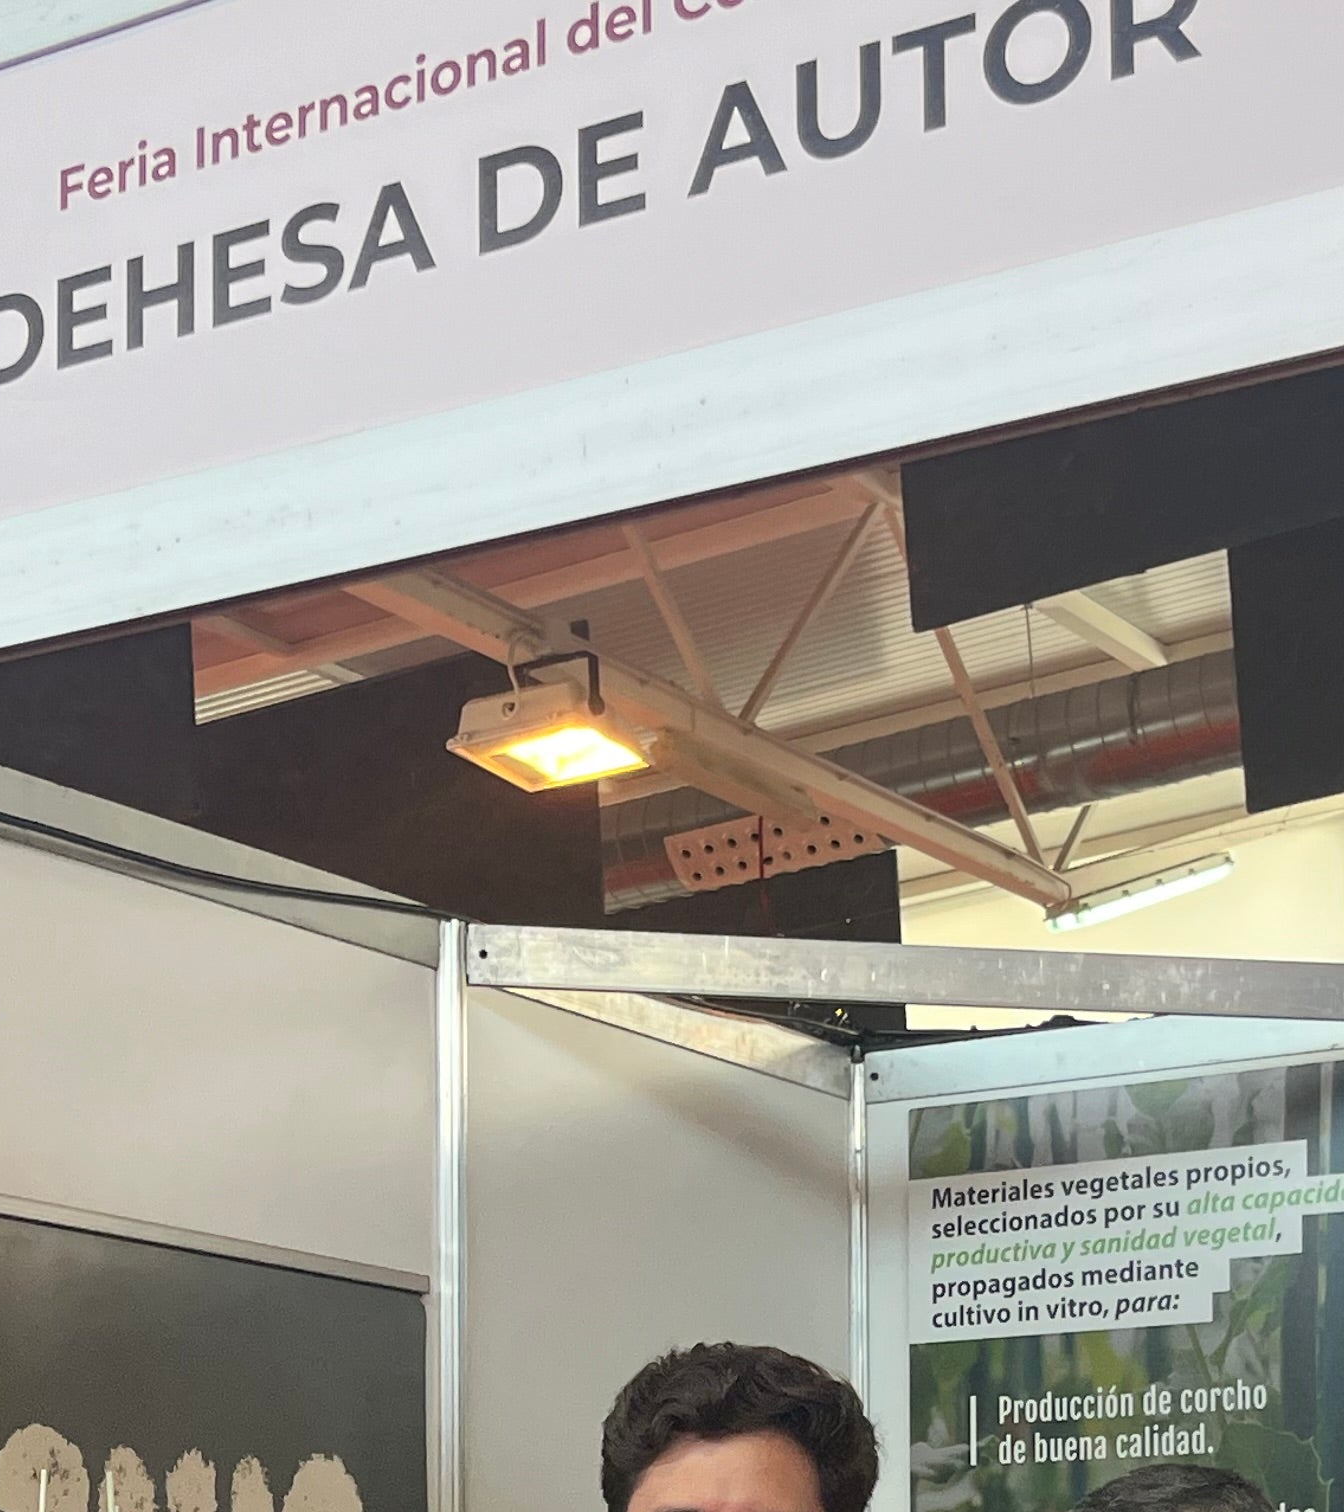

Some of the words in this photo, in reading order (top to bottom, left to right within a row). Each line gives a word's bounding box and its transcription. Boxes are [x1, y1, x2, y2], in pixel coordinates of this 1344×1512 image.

[58, 138, 178, 211] Feria
[194, 18, 548, 170] Internacional
[566, 0, 653, 56] del
[477, 109, 647, 255] DE
[686, 0, 1203, 198] AUTOR
[931, 1178, 1055, 1210] Materiales
[1061, 1165, 1179, 1199] vegetales
[1186, 1156, 1291, 1190] propios,
[931, 1205, 1097, 1239] seleccionados
[1104, 1203, 1147, 1229] por
[1152, 1200, 1180, 1219] su
[1186, 1190, 1235, 1216] alta
[930, 1244, 1057, 1274] productiva
[1059, 1240, 1076, 1264] y
[1079, 1225, 1178, 1257] sanidad
[1183, 1217, 1283, 1251] vegetal,
[931, 1267, 1074, 1304] propagados
[1081, 1258, 1199, 1287] mediante
[931, 1304, 1011, 1328] cultivo
[1017, 1300, 1039, 1322] in
[1046, 1297, 1109, 1319] vitro,
[1114, 1293, 1181, 1320] para:
[998, 1384, 1134, 1425] Producción
[1142, 1384, 1172, 1417] de
[1179, 1378, 1268, 1415] corcho
[998, 1434, 1026, 1465] de
[1034, 1432, 1107, 1464] buena
[1115, 1422, 1215, 1460] calidad.
